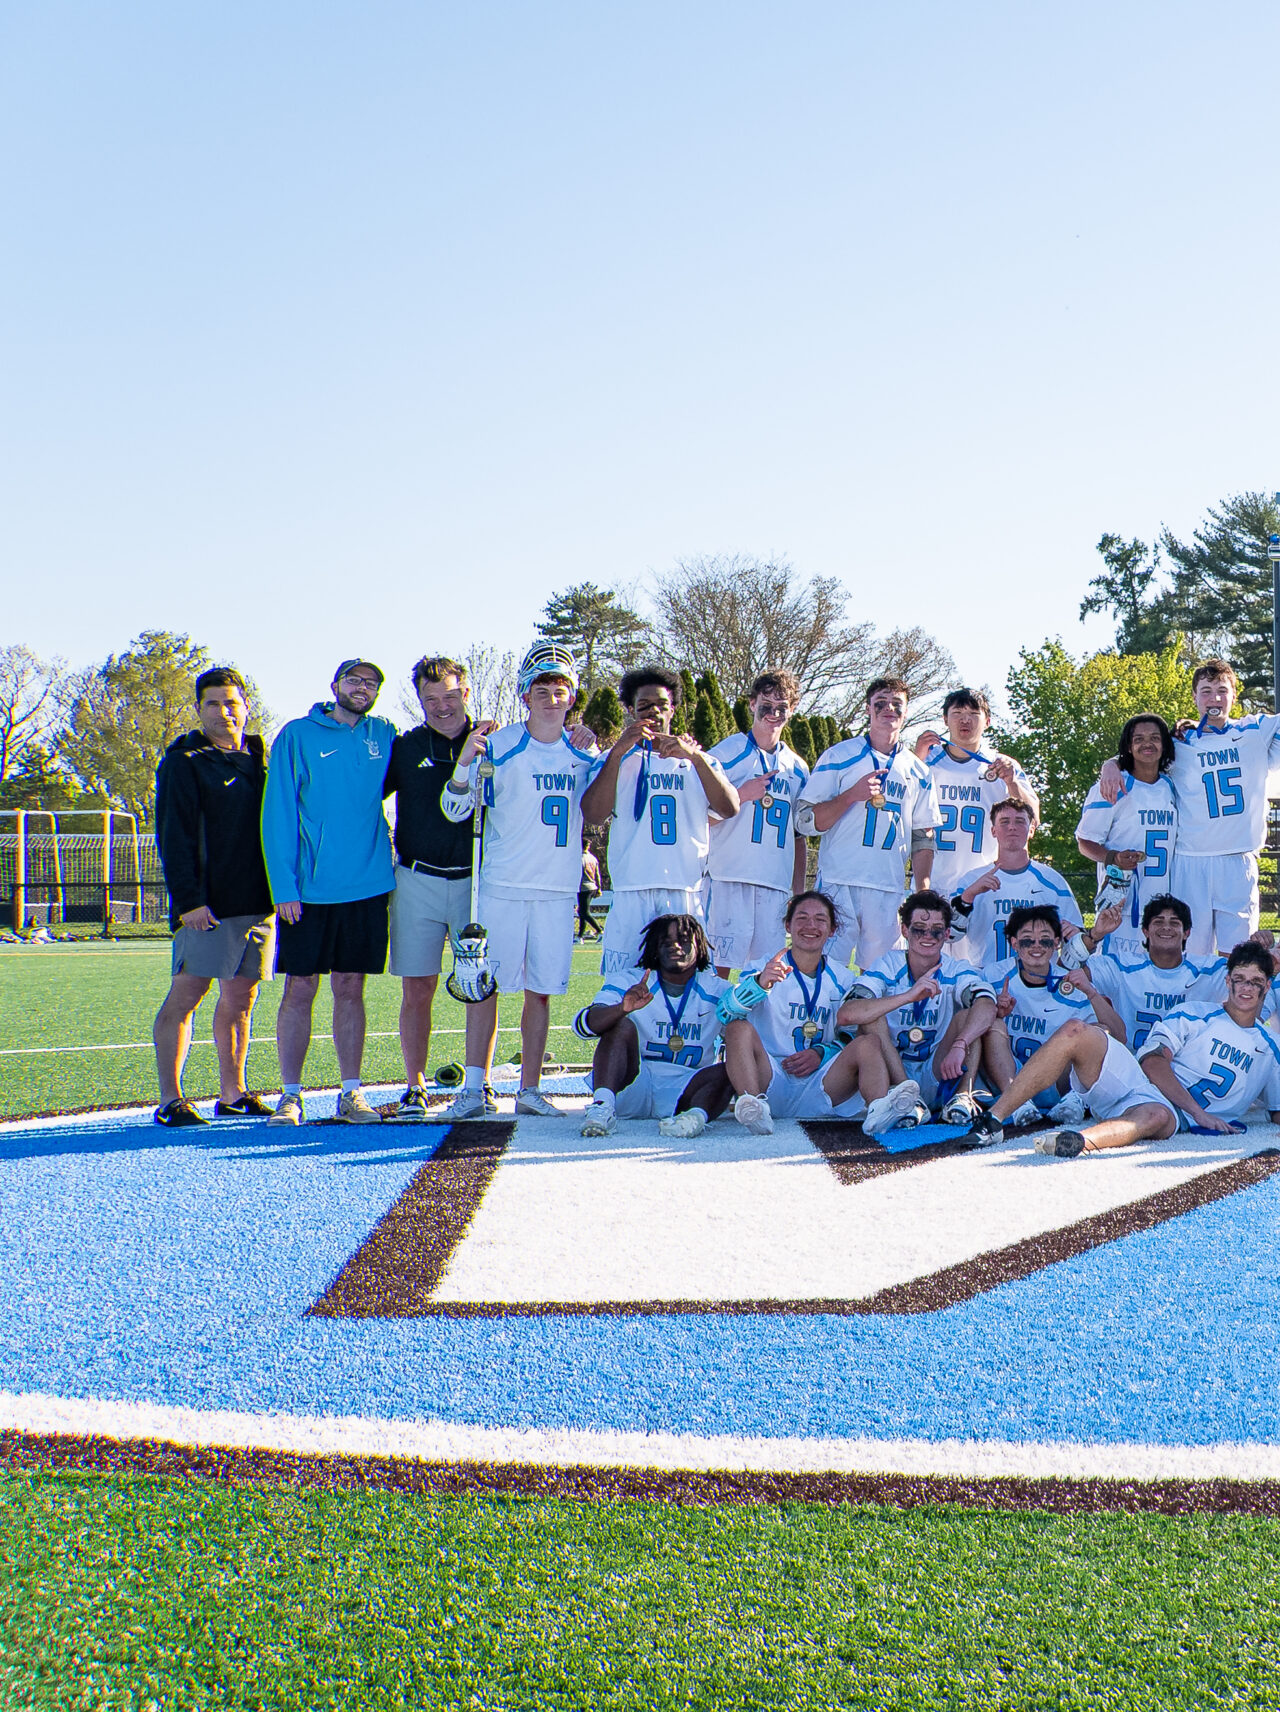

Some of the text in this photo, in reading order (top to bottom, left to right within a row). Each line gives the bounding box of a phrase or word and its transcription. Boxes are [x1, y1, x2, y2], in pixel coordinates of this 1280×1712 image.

[1197, 747, 1240, 767] TOWN
[533, 774, 576, 791] TOWN
[648, 773, 684, 791] OWN
[939, 784, 981, 801] TOWN
[1202, 767, 1245, 819] 15
[541, 795, 569, 847] 9
[650, 794, 677, 845] 8
[751, 798, 791, 850] 19
[862, 799, 901, 850] 17
[935, 804, 985, 853] 29
[1138, 809, 1174, 825] TOWN
[1144, 830, 1168, 877] 5
[1209, 1038, 1254, 1074] TOWN
[1187, 1063, 1236, 1110] 2
